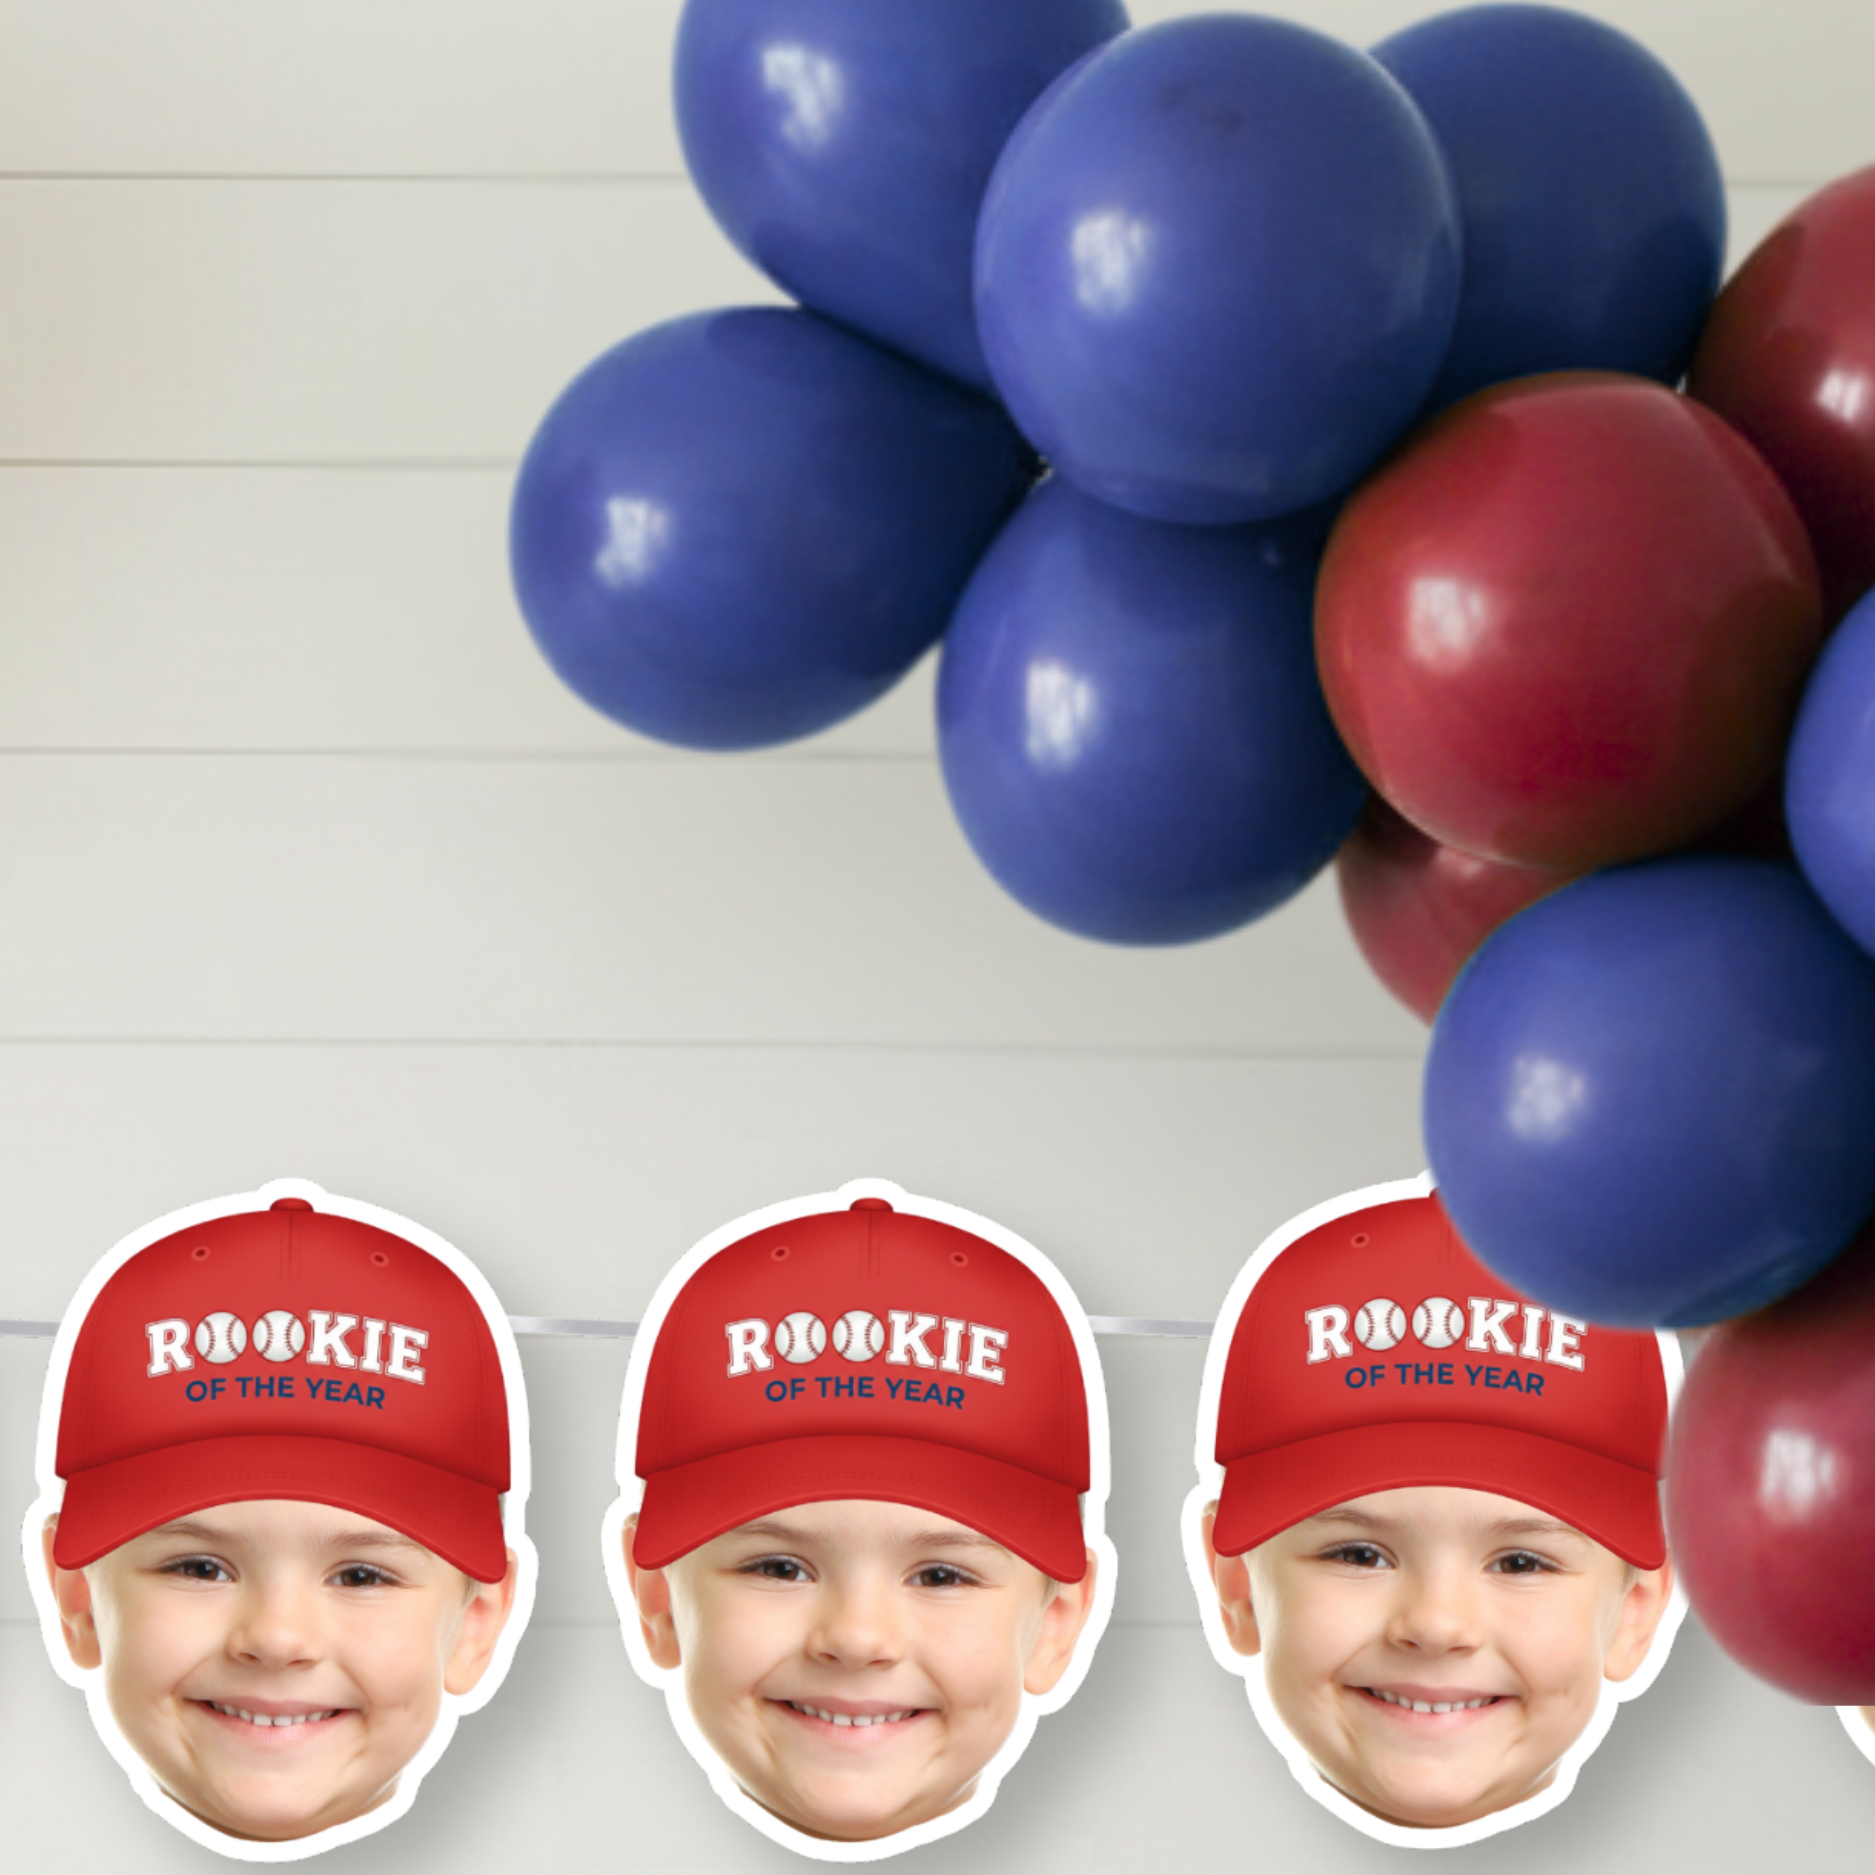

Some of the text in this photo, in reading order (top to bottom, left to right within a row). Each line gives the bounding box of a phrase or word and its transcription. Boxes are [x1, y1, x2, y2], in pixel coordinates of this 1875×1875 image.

[146, 1309, 430, 1386] ROOKIE
[725, 1309, 1009, 1386] ROOKIE
[1304, 1297, 1588, 1372] ROOKIE
[186, 1376, 386, 1410] OF THE YEAR
[765, 1376, 965, 1410] OF THE YEAR
[1344, 1363, 1545, 1396] OF THE YEAR
